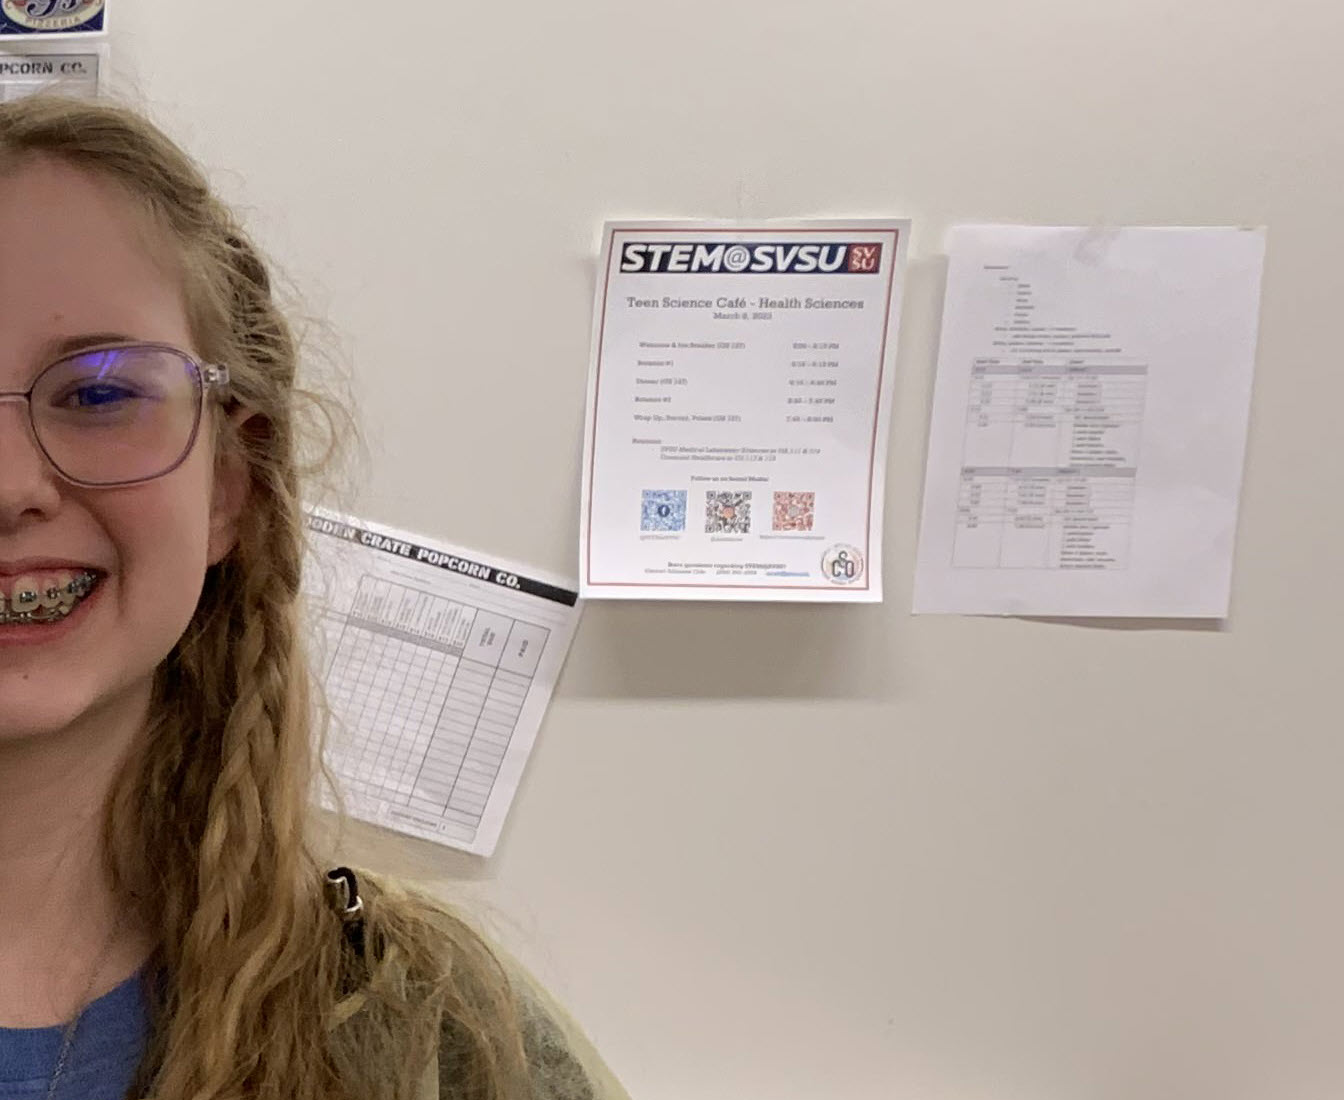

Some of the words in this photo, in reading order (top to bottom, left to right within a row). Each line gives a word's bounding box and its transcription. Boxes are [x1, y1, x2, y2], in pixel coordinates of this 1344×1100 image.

[621, 244, 848, 272] STEM@SVSU
[627, 297, 659, 308] Teen
[663, 297, 712, 308] Science
[716, 297, 746, 309] Café
[758, 297, 801, 309] Health
[804, 298, 864, 309] Sciences
[361, 531, 412, 557] CRATE
[417, 548, 491, 580] POPCORN
[496, 571, 521, 589] CO.
